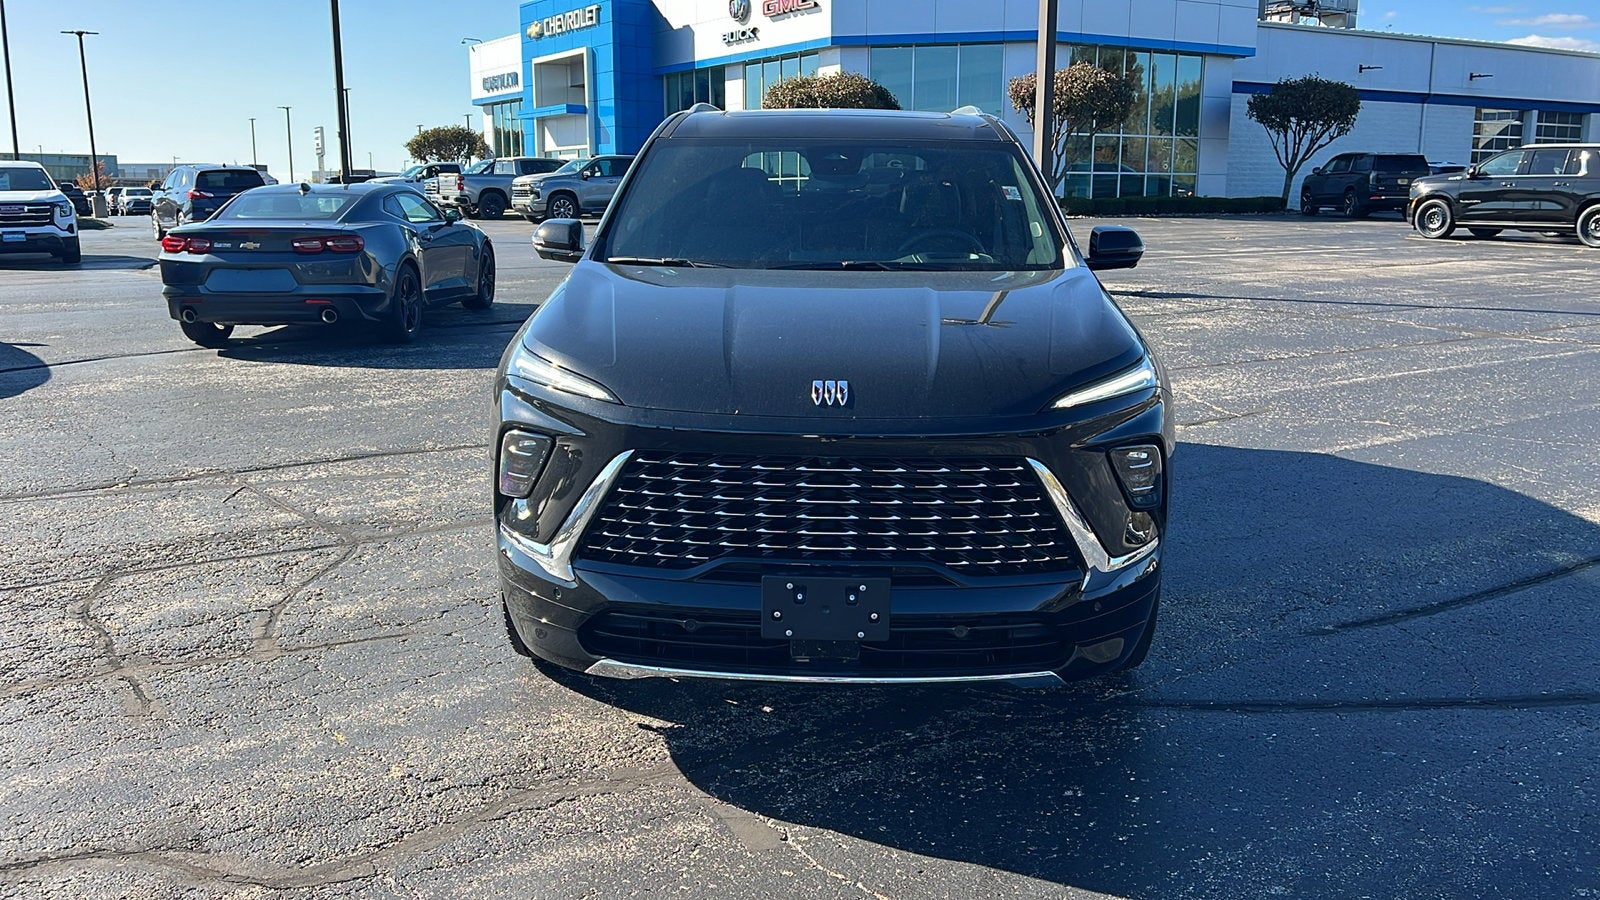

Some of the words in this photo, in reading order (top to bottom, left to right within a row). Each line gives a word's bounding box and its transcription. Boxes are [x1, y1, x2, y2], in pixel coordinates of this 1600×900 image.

[763, 0, 816, 17] GMC
[543, 4, 600, 37] CHEVROLET
[722, 28, 756, 42] BUICK
